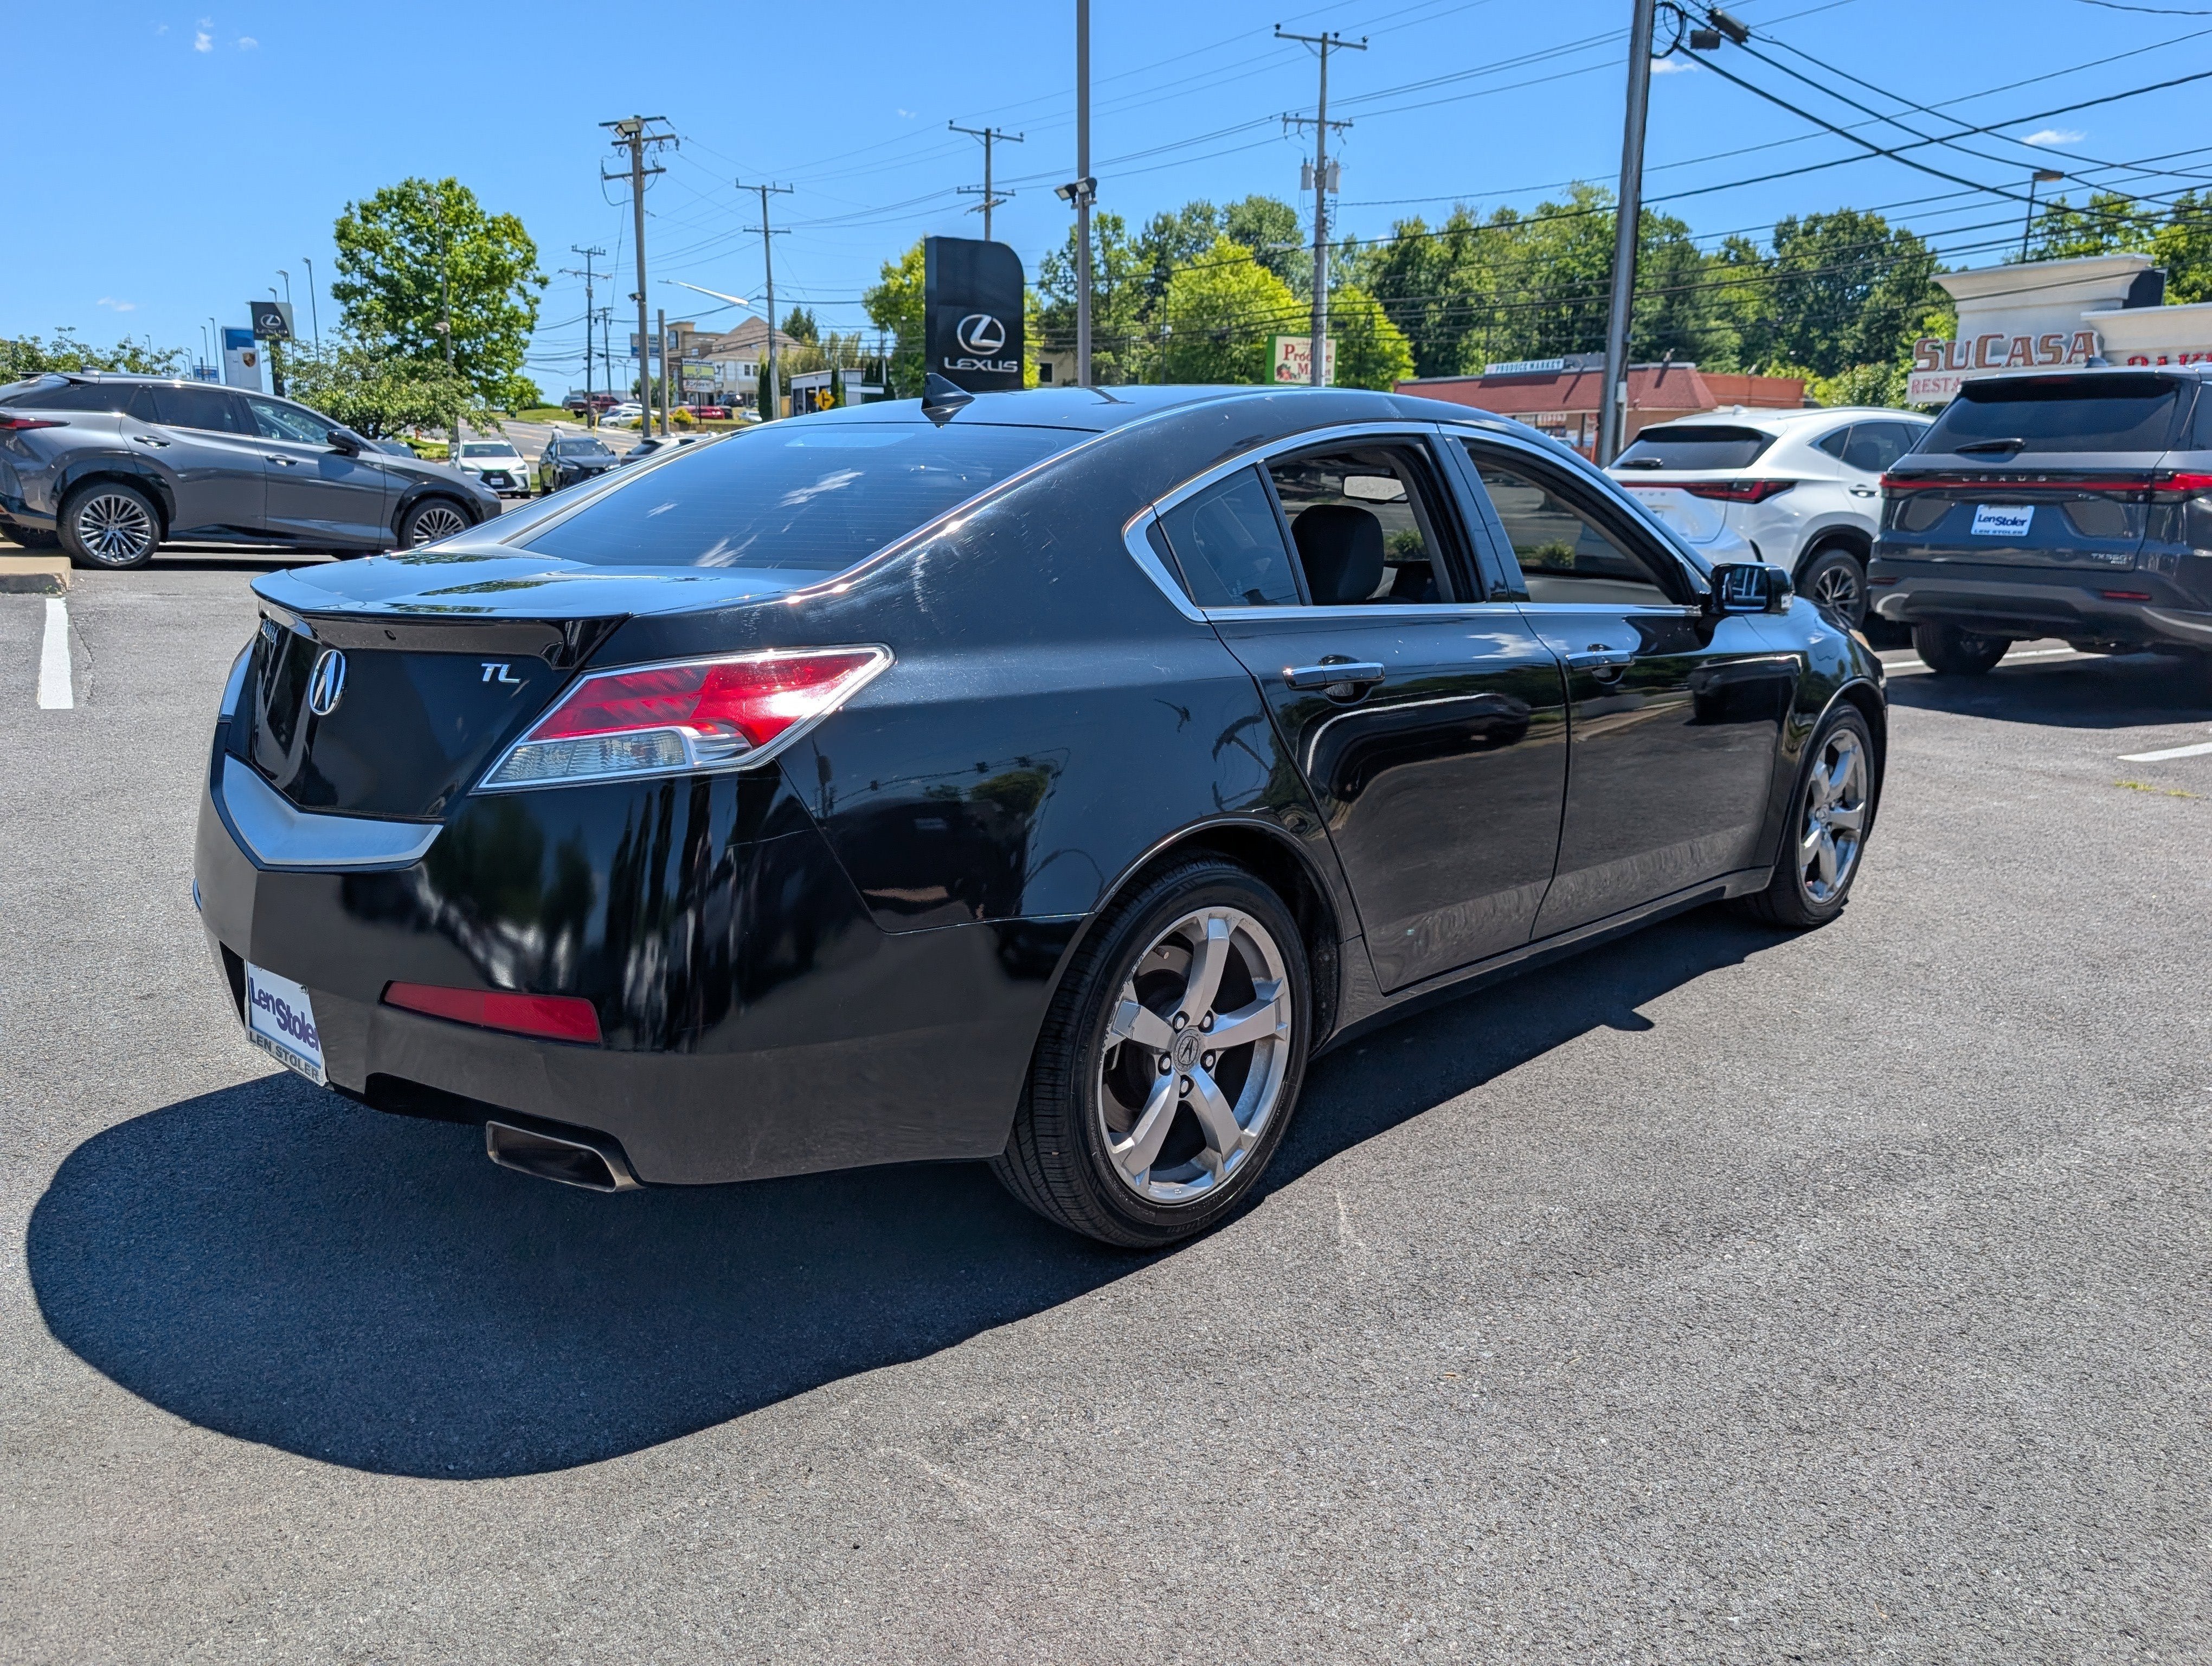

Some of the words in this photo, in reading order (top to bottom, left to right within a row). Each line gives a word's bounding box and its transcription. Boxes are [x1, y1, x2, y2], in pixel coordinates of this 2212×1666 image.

[1283, 343, 1332, 362] Prode
[944, 356, 1018, 373] LEXUS
[1911, 376, 1962, 394] RESTA
[481, 663, 521, 683] TL
[249, 1031, 272, 1051] LEN
[275, 1045, 320, 1082] STOLER
